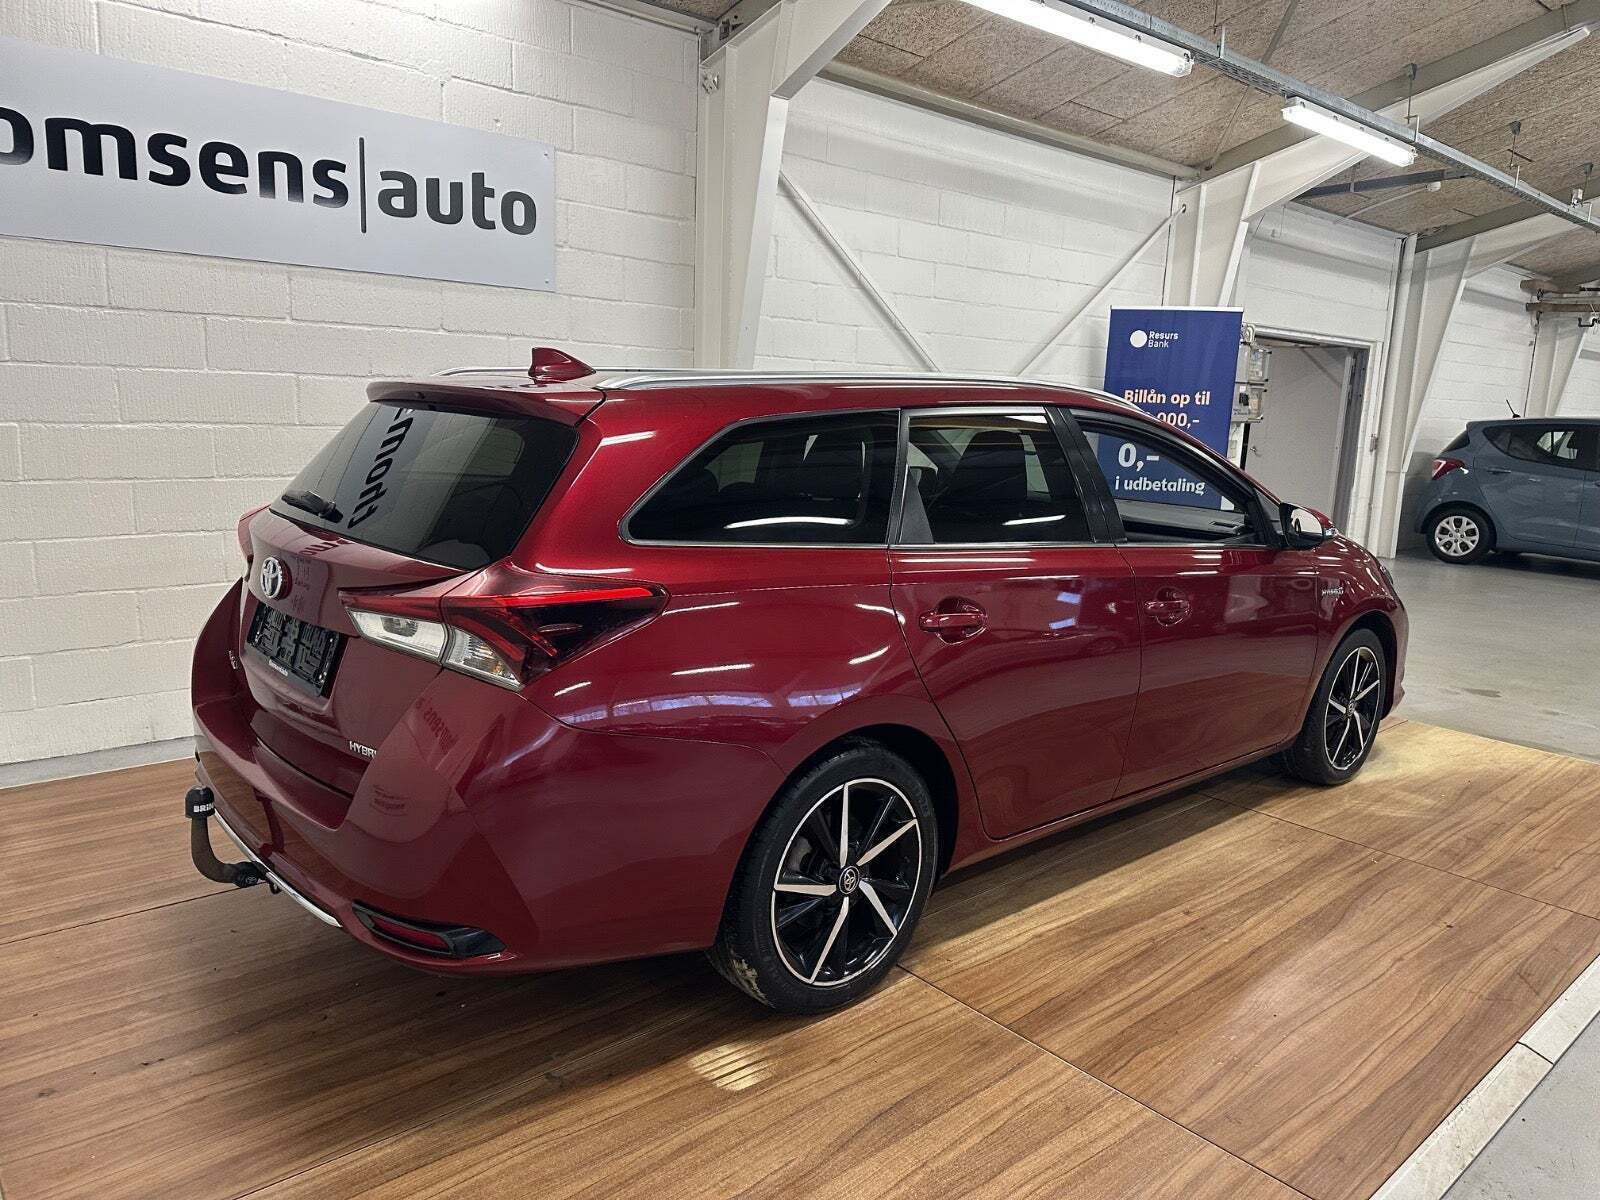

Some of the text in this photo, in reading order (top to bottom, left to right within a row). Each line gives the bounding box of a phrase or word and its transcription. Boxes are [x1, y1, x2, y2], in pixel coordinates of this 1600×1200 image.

[0, 106, 538, 236] omsens auto
[1148, 340, 1169, 348] Bank
[1149, 331, 1179, 340] Resurs
[1124, 389, 1211, 408] Billån op til
[1115, 476, 1206, 497] i udbetaling
